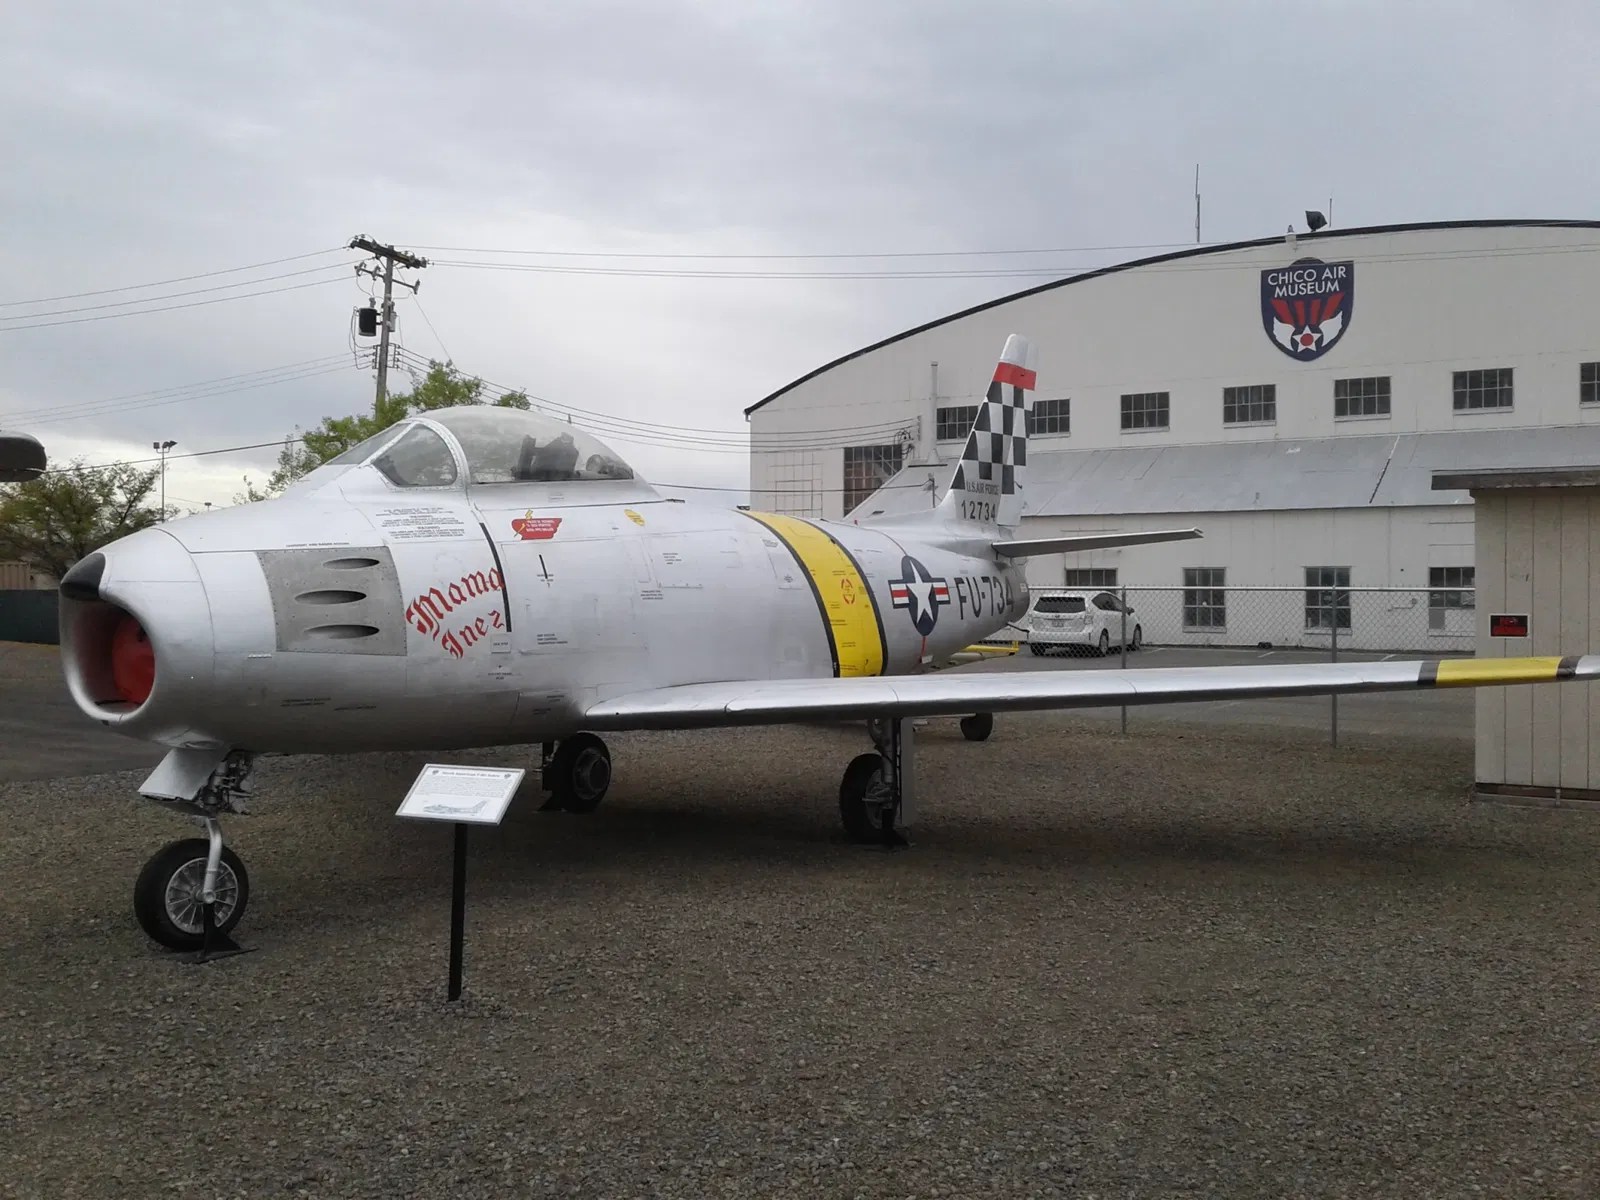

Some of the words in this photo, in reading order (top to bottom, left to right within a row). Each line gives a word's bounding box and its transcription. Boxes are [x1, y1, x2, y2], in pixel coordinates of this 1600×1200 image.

[1267, 269, 1317, 286] CHICO
[1321, 266, 1347, 280] AIR
[1274, 280, 1340, 298] MUSEUM
[961, 500, 996, 522] 12734
[405, 567, 505, 642] Mama
[954, 576, 1015, 620] FU-734
[441, 610, 505, 660] Inez
